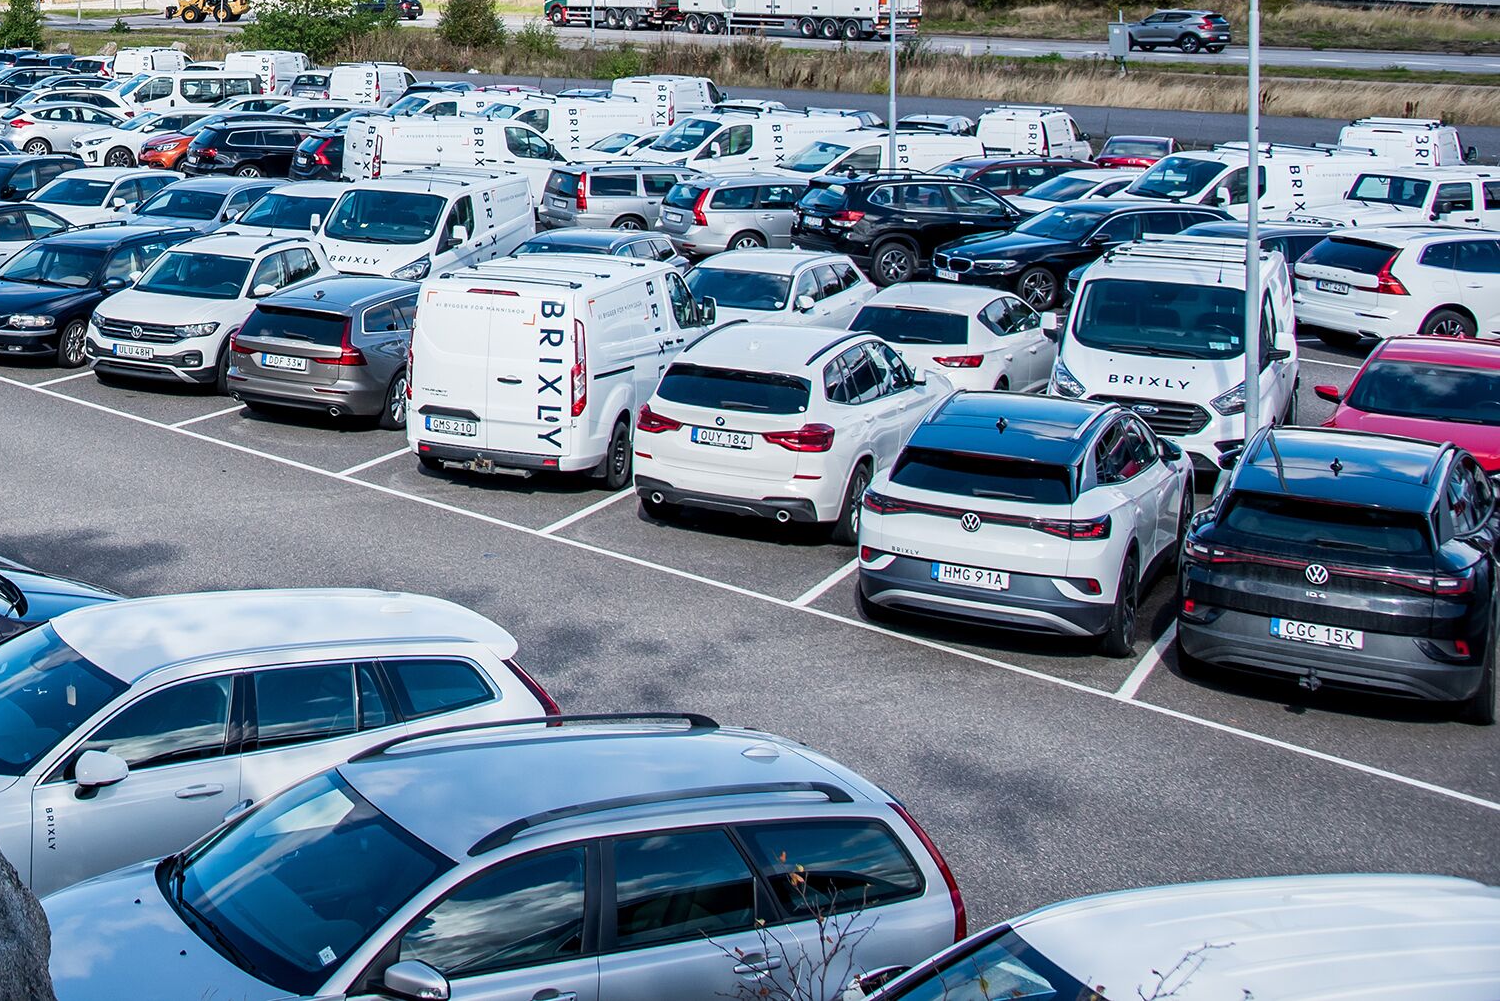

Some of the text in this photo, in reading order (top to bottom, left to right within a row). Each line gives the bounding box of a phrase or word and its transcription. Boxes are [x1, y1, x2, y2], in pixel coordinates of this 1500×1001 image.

[656, 84, 668, 127] BRIXL
[568, 108, 580, 150] BRIXL
[329, 254, 381, 266] BRIXLY
[119, 346, 151, 357] ULU 48H
[268, 356, 303, 368] DDF 33W
[537, 300, 566, 449] BRIXLY
[1108, 374, 1190, 390] BRIXLY
[433, 419, 472, 432] GMS 210
[701, 430, 747, 445] OUY 184
[892, 545, 920, 555] BRIXLY
[943, 565, 1003, 586] HMG 91A
[1285, 621, 1355, 645] CGC 15K
[45, 807, 57, 851] BRIXLY
